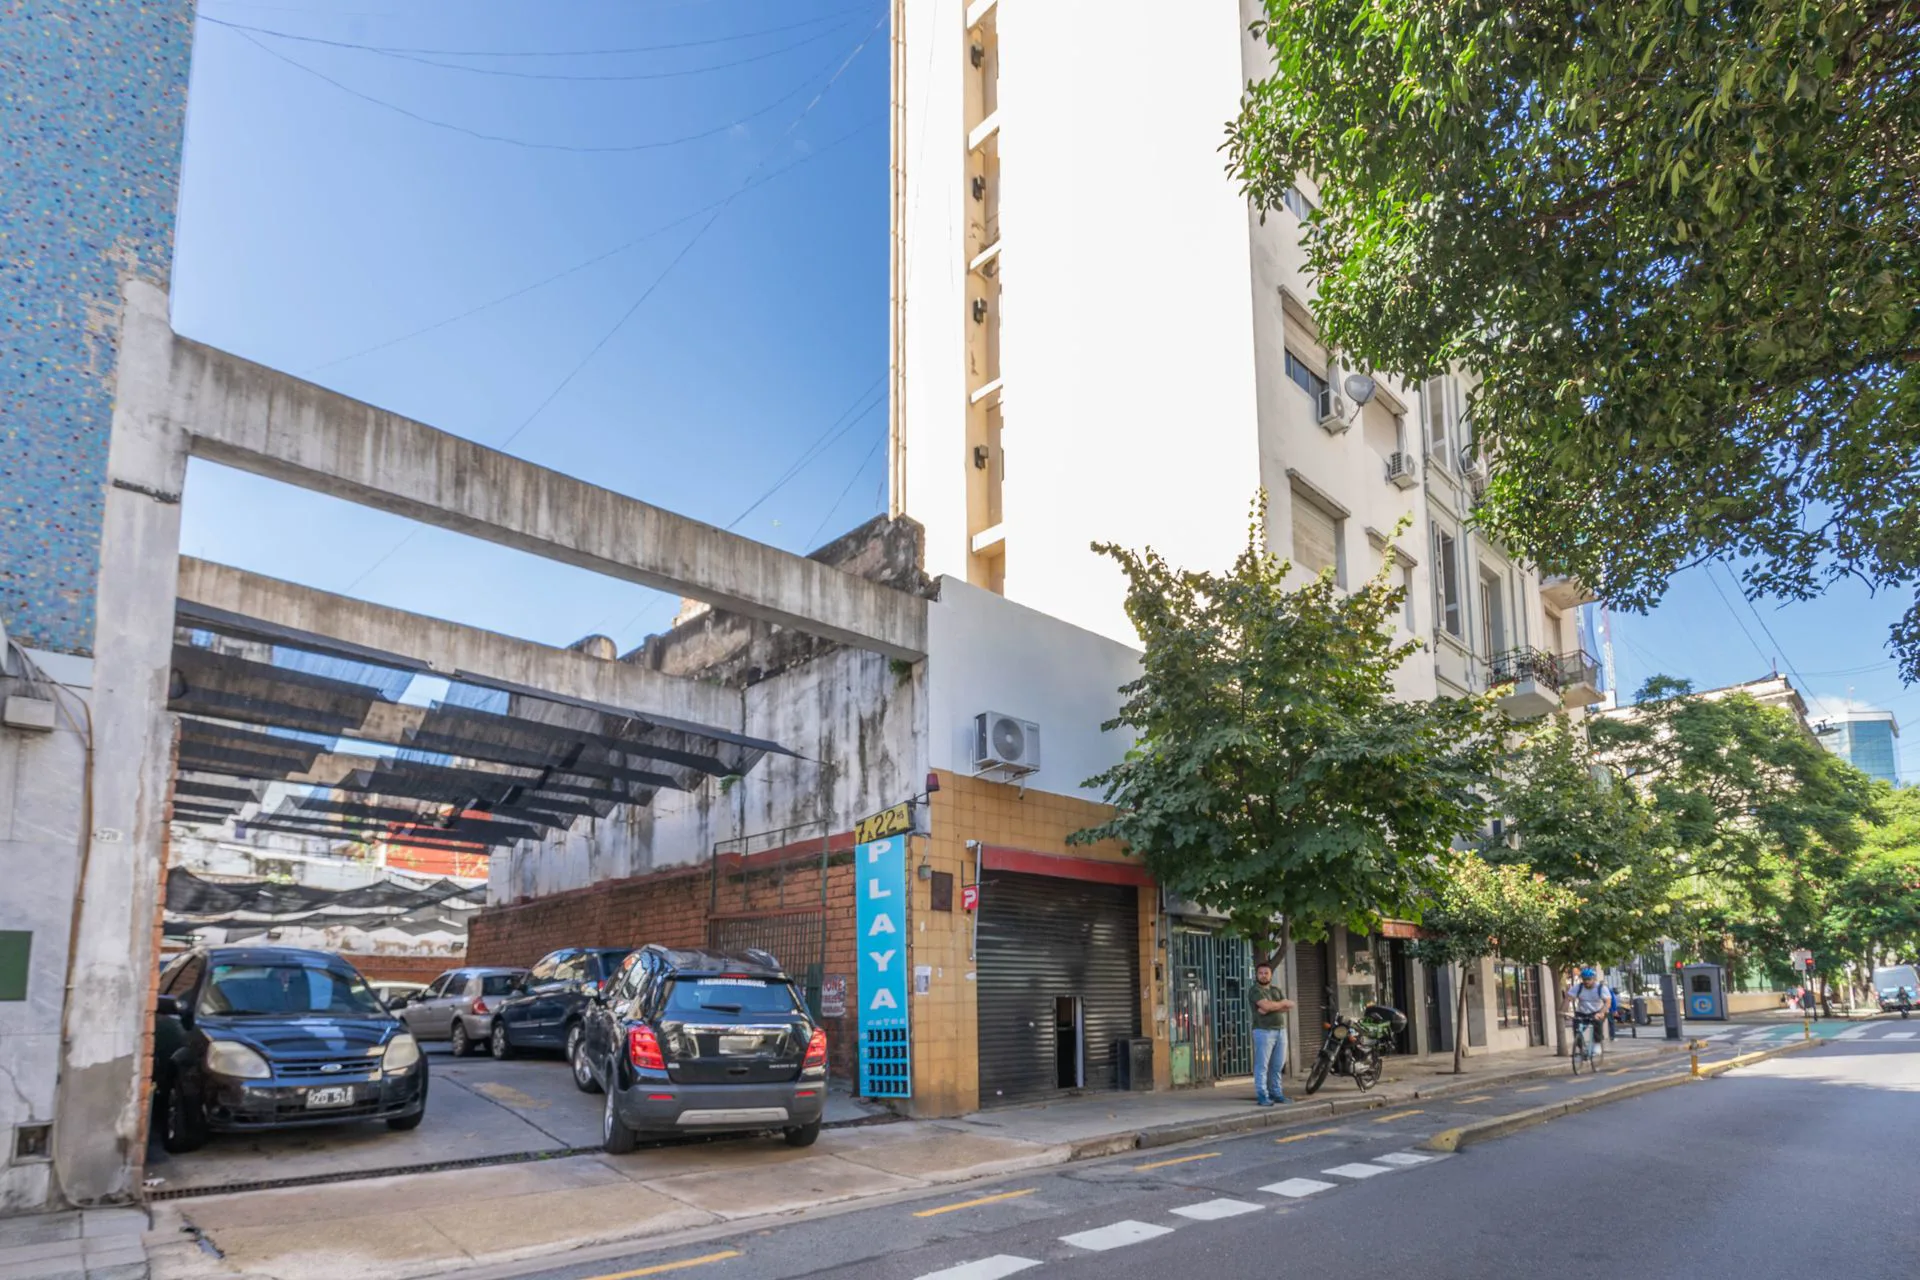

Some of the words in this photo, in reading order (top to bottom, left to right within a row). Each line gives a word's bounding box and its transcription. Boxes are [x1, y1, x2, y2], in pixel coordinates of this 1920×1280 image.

[856, 821, 866, 845] 7
[874, 810, 897, 837] 22
[964, 890, 976, 908] P
[868, 840, 898, 1010] PLAYA
